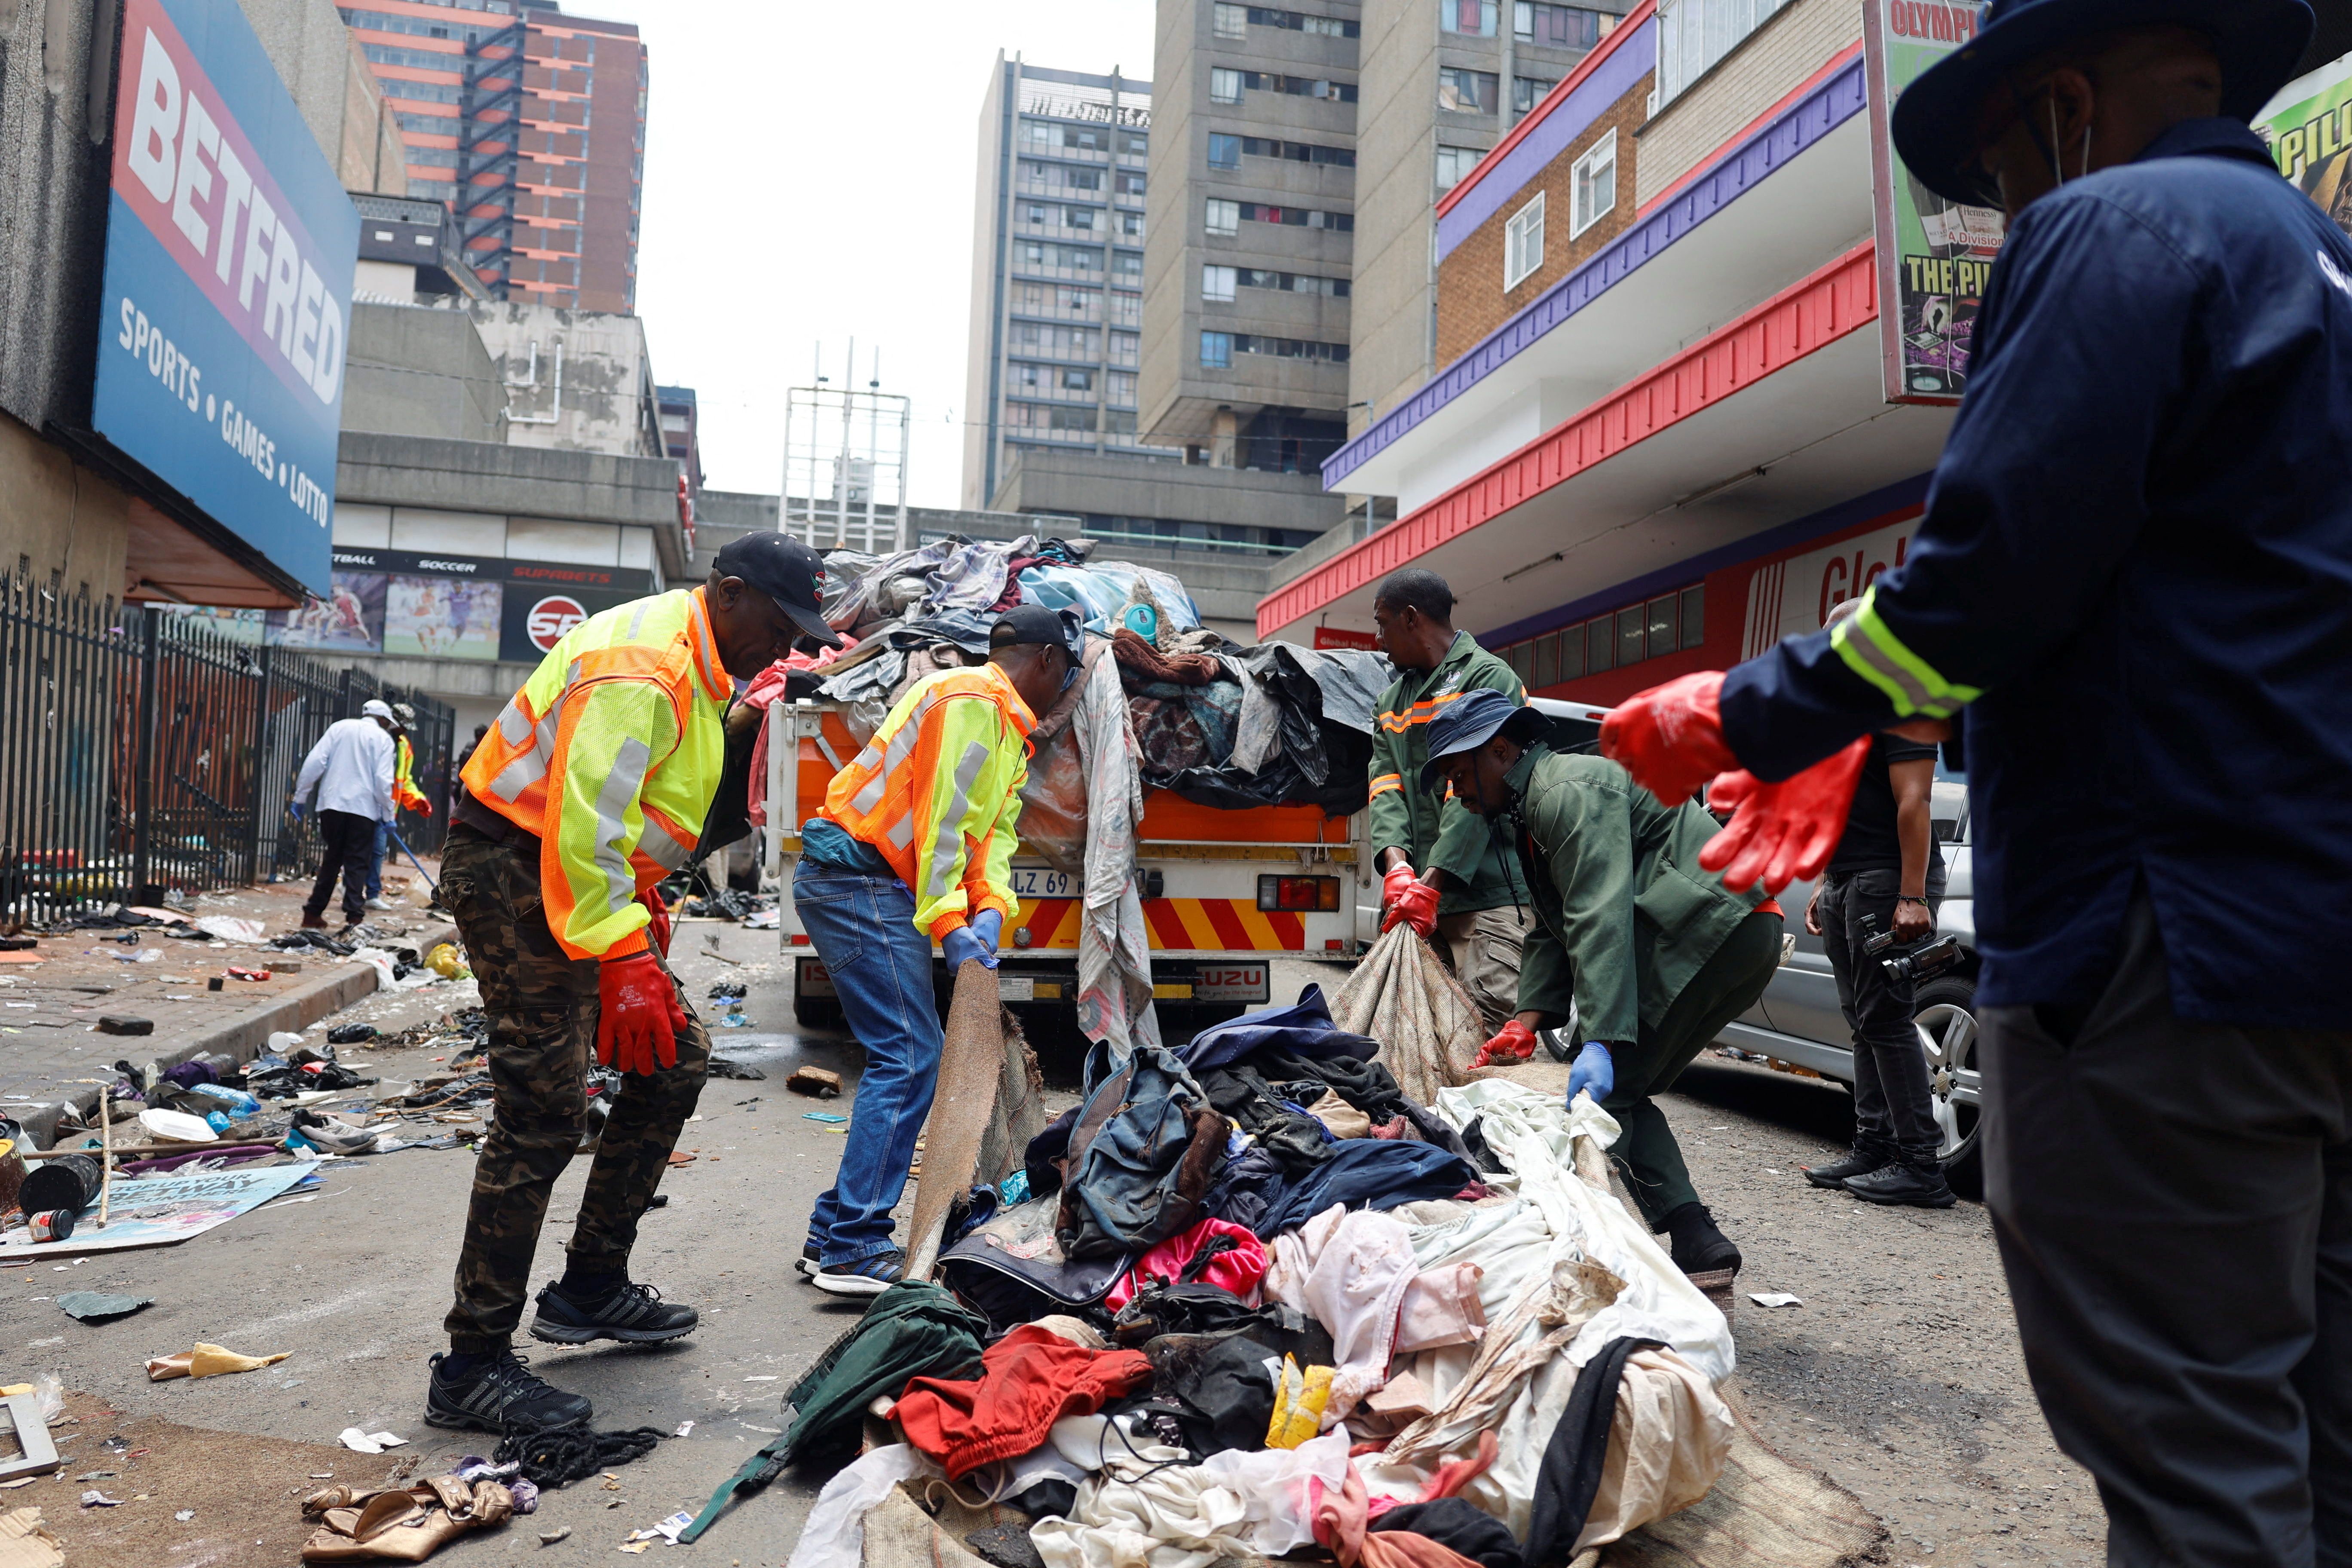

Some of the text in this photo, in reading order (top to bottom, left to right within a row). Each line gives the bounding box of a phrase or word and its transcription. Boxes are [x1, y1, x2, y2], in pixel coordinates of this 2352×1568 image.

[1892, 0, 1978, 43] OLYMPI
[128, 26, 343, 405] BETFRED
[1964, 207, 1997, 220] Hennessy
[1948, 231, 2005, 246] A Division
[1905, 255, 1953, 295] THE
[119, 297, 328, 528] SPORTS GAMES LOTTO
[330, 553, 376, 566] TBALL
[418, 559, 477, 573] SOCCER
[512, 566, 612, 584] SUPABETS
[1320, 637, 1372, 650] Global Meat
[1014, 873, 1036, 893] LZ
[1046, 873, 1068, 894] 69
[194, 1174, 252, 1184] YOUR
[108, 1178, 268, 1202] BETWAY
